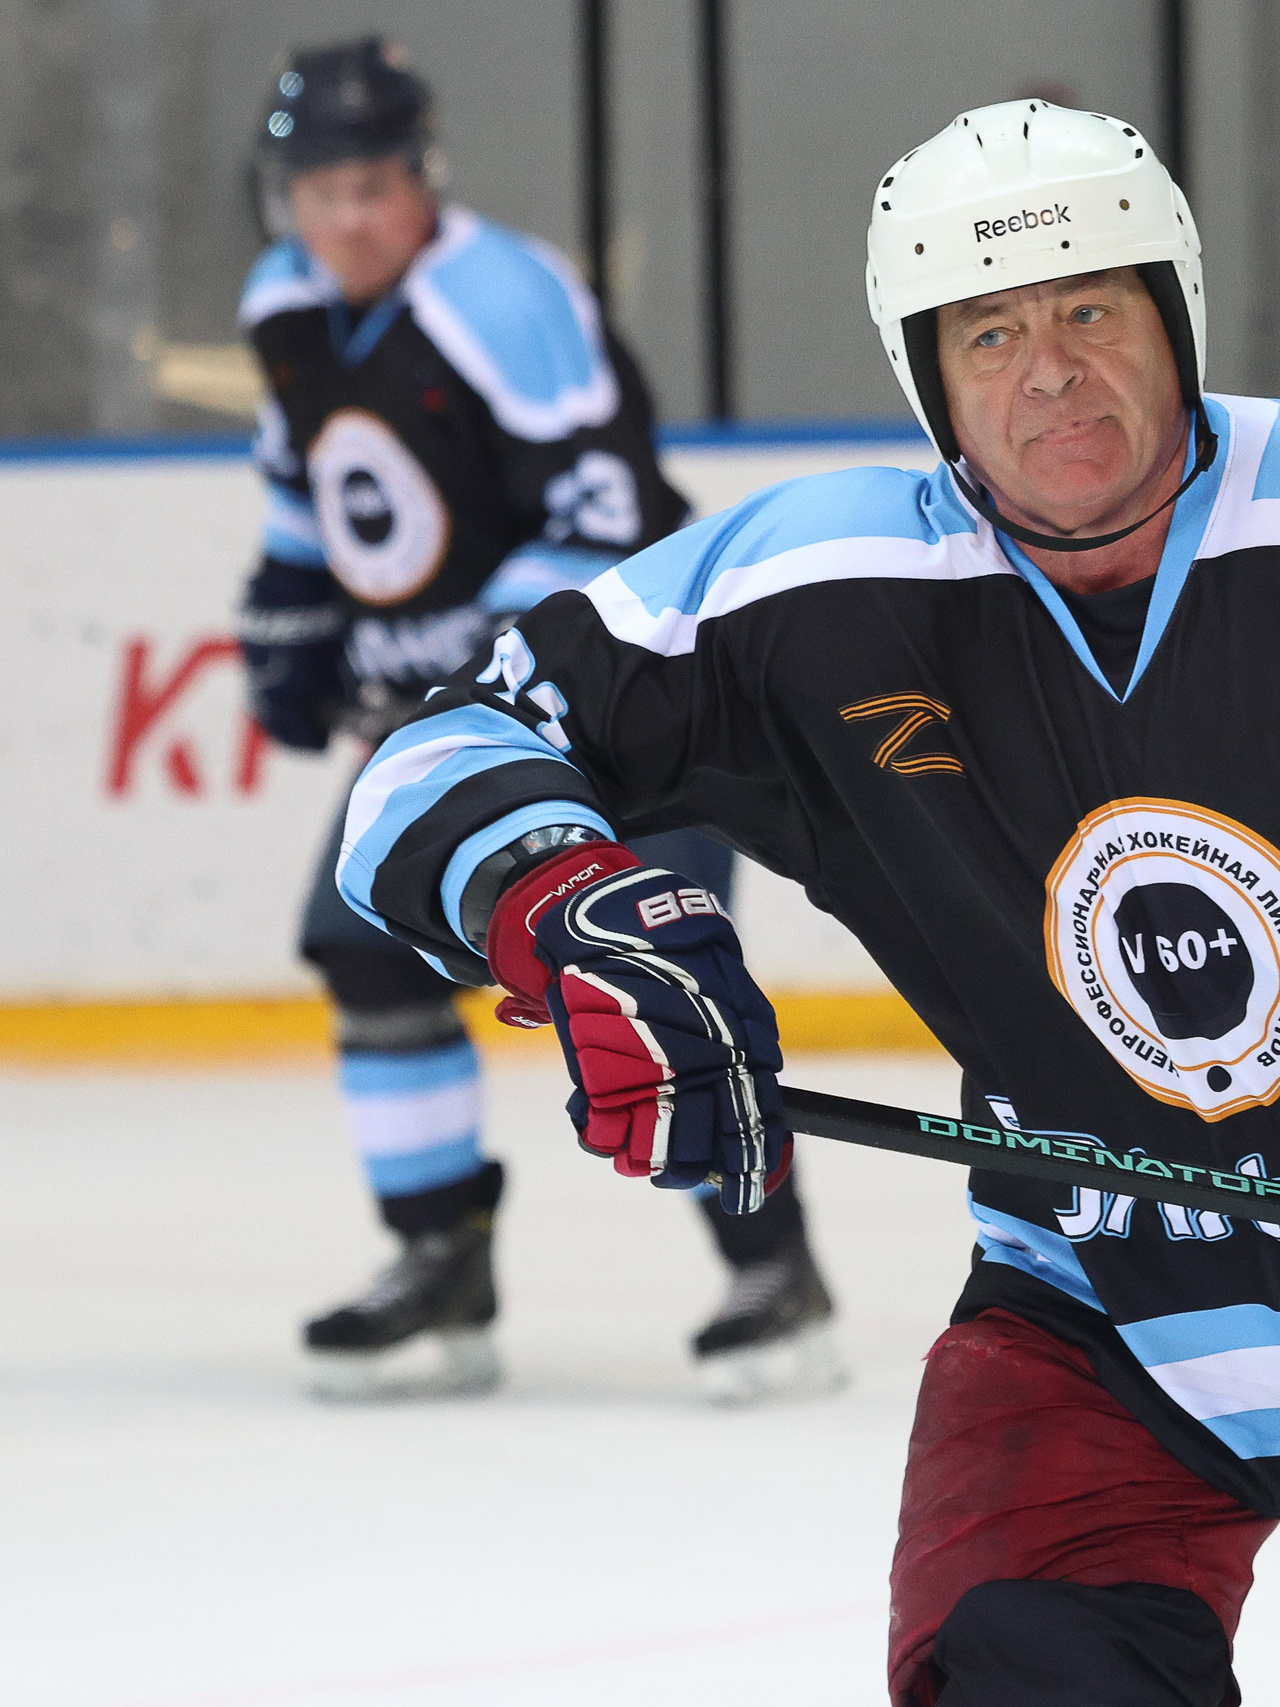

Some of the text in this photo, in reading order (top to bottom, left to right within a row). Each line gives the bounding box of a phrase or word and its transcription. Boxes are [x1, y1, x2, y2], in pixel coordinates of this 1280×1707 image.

[974, 204, 1071, 242] Reebok
[549, 863, 604, 897] VAPOR
[1126, 831, 1260, 889] ХОКЕЙНАЯ
[1156, 929, 1238, 973] 60+
